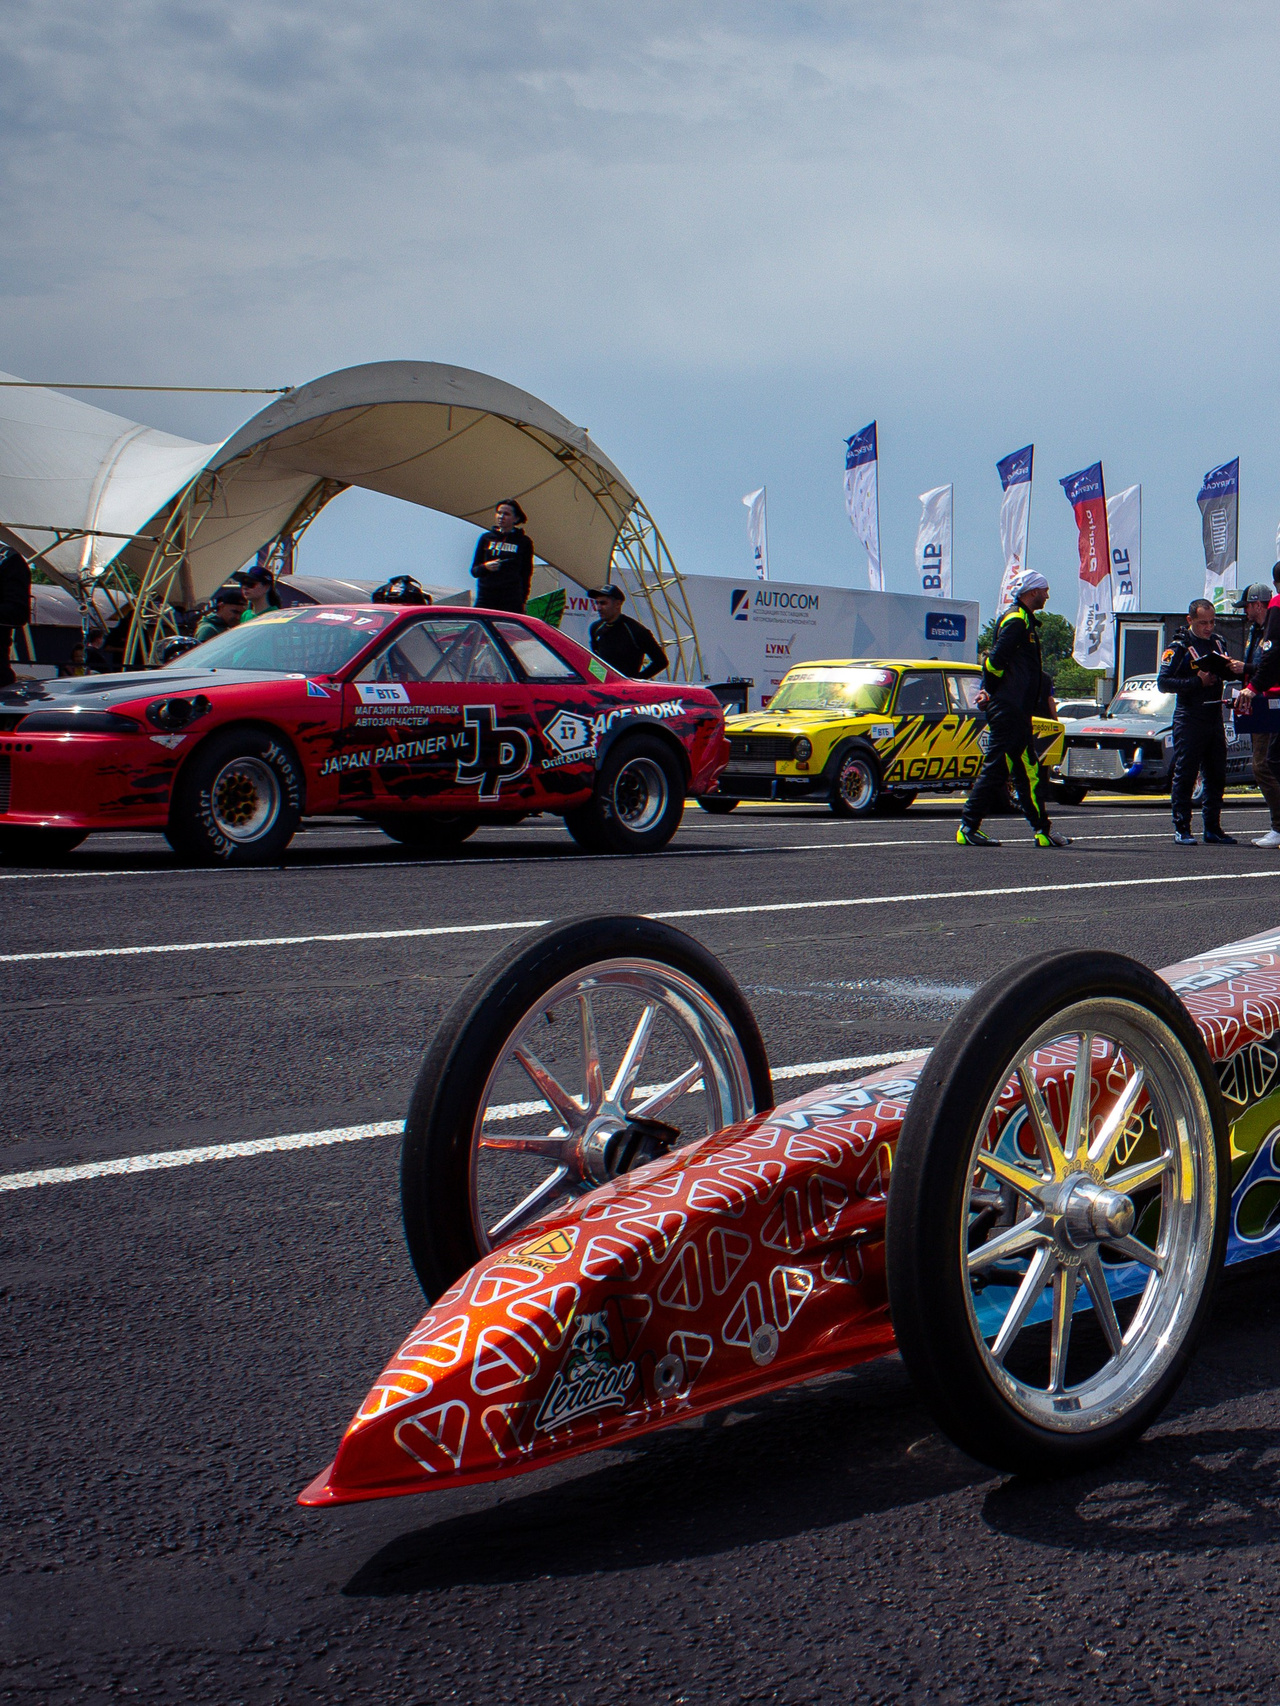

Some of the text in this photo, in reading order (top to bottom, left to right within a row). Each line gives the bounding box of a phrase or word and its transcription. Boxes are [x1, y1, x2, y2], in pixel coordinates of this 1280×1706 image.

[755, 591, 819, 610] AUTOCOM
[376, 688, 401, 700] ВТБ
[354, 705, 460, 716] МАГАЗИН КОНТРАКТНЫХ
[560, 726, 577, 740] 17
[320, 731, 470, 776] JAPAN PARTNER VL
[496, 1256, 557, 1273] LEMARC
